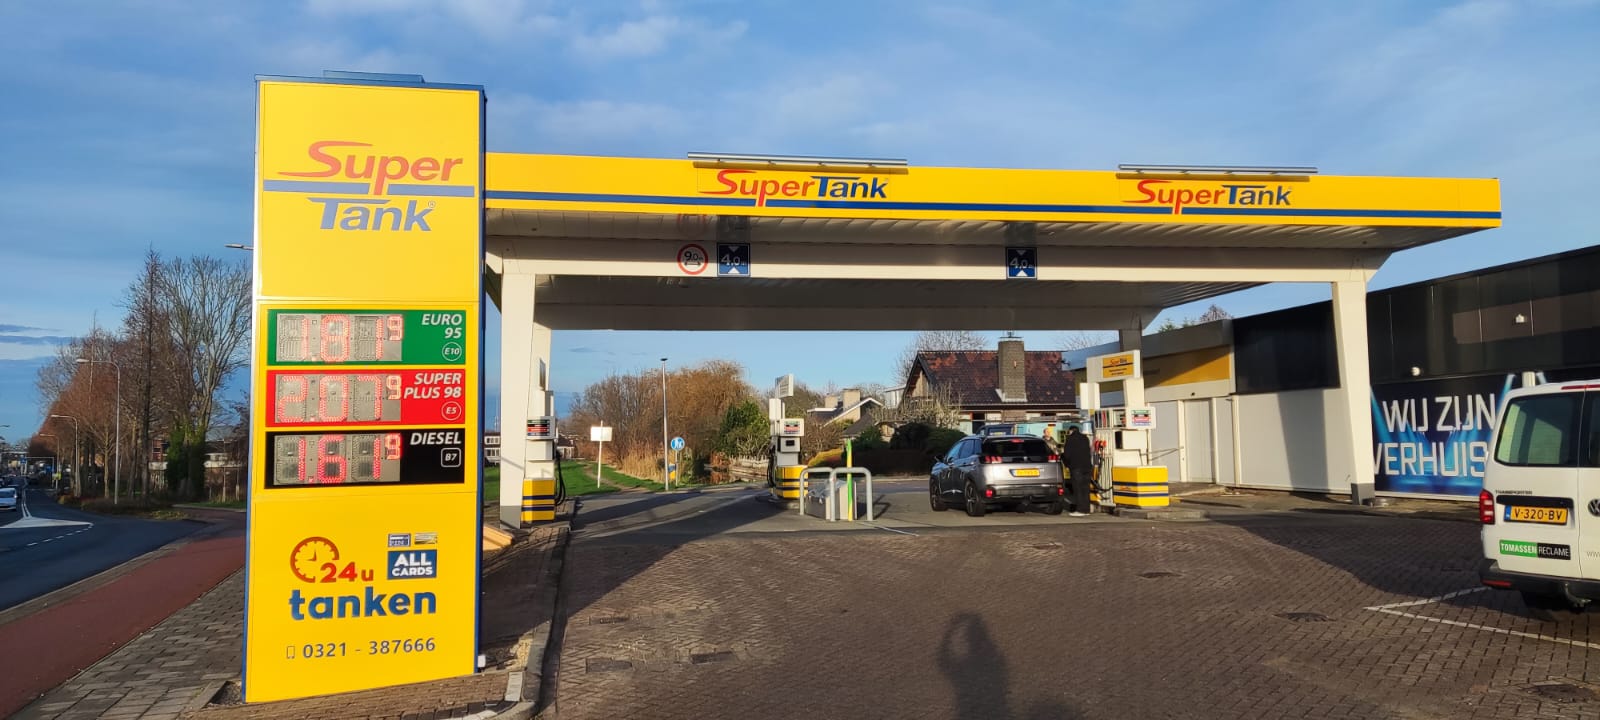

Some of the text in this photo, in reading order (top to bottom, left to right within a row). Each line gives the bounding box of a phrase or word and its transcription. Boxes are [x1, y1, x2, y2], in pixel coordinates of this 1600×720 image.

[277, 141, 464, 195] Super
[421, 313, 463, 326] EURO
[444, 327, 462, 339] 95
[444, 347, 460, 356] E10
[414, 372, 462, 385] SUPER
[403, 385, 462, 399] PLUS 98
[445, 406, 457, 415] E5
[1382, 392, 1496, 433] WIJ ZIJN
[409, 431, 462, 446] DIESEL
[444, 453, 457, 462] B7
[1514, 508, 1563, 521] V-320-BV
[1501, 543, 1569, 557] TOMASSEN RECLAME
[394, 552, 432, 567] ALL
[391, 566, 433, 576] CARDS
[289, 586, 437, 621] tanken
[302, 642, 347, 658] 0321
[369, 637, 436, 655] 387666
